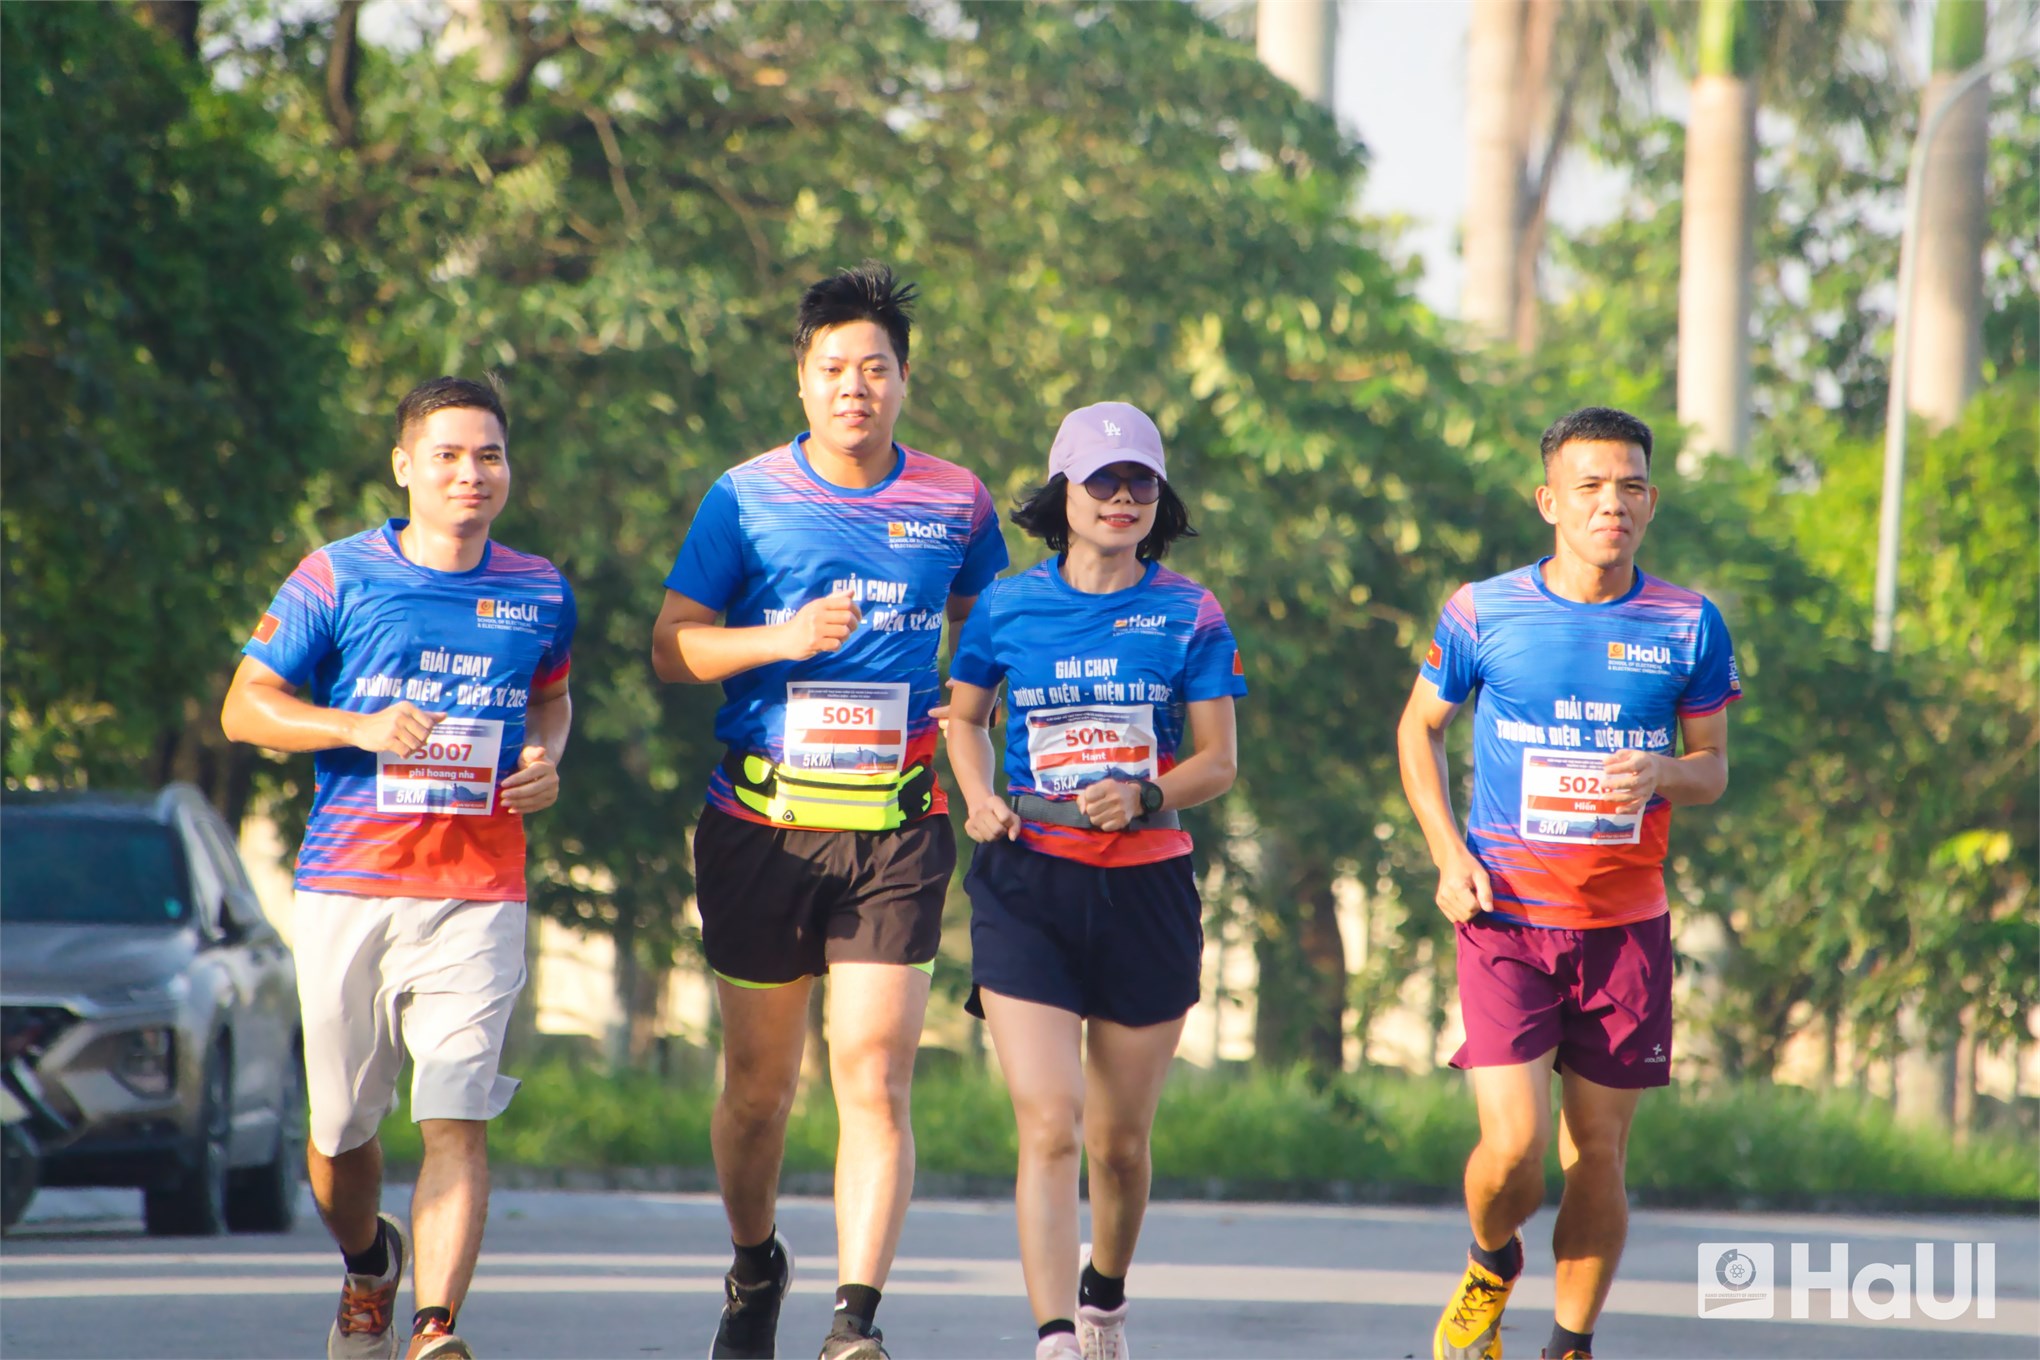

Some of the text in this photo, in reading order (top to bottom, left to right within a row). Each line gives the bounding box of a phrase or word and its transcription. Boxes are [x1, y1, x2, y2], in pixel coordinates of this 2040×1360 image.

[1103, 420, 1121, 436] LA
[906, 521, 948, 540] HaUI
[867, 579, 908, 609] CHẠY
[496, 600, 539, 623] HaUI
[1128, 614, 1167, 628] HaUI
[1627, 643, 1671, 665] HaUI
[420, 646, 493, 682] GIẢI CHẠY
[1084, 658, 1118, 681] CHẠY
[1128, 678, 1145, 702] TỬ
[822, 707, 874, 725] 5051
[1554, 694, 1622, 726] GIẢI CHẠY
[1065, 727, 1119, 747] 5018
[414, 743, 473, 762] 5007
[803, 753, 832, 767] 5KM
[409, 769, 475, 780] phi hoang nha
[395, 788, 426, 805] 5KM
[1538, 820, 1568, 836] 5KM
